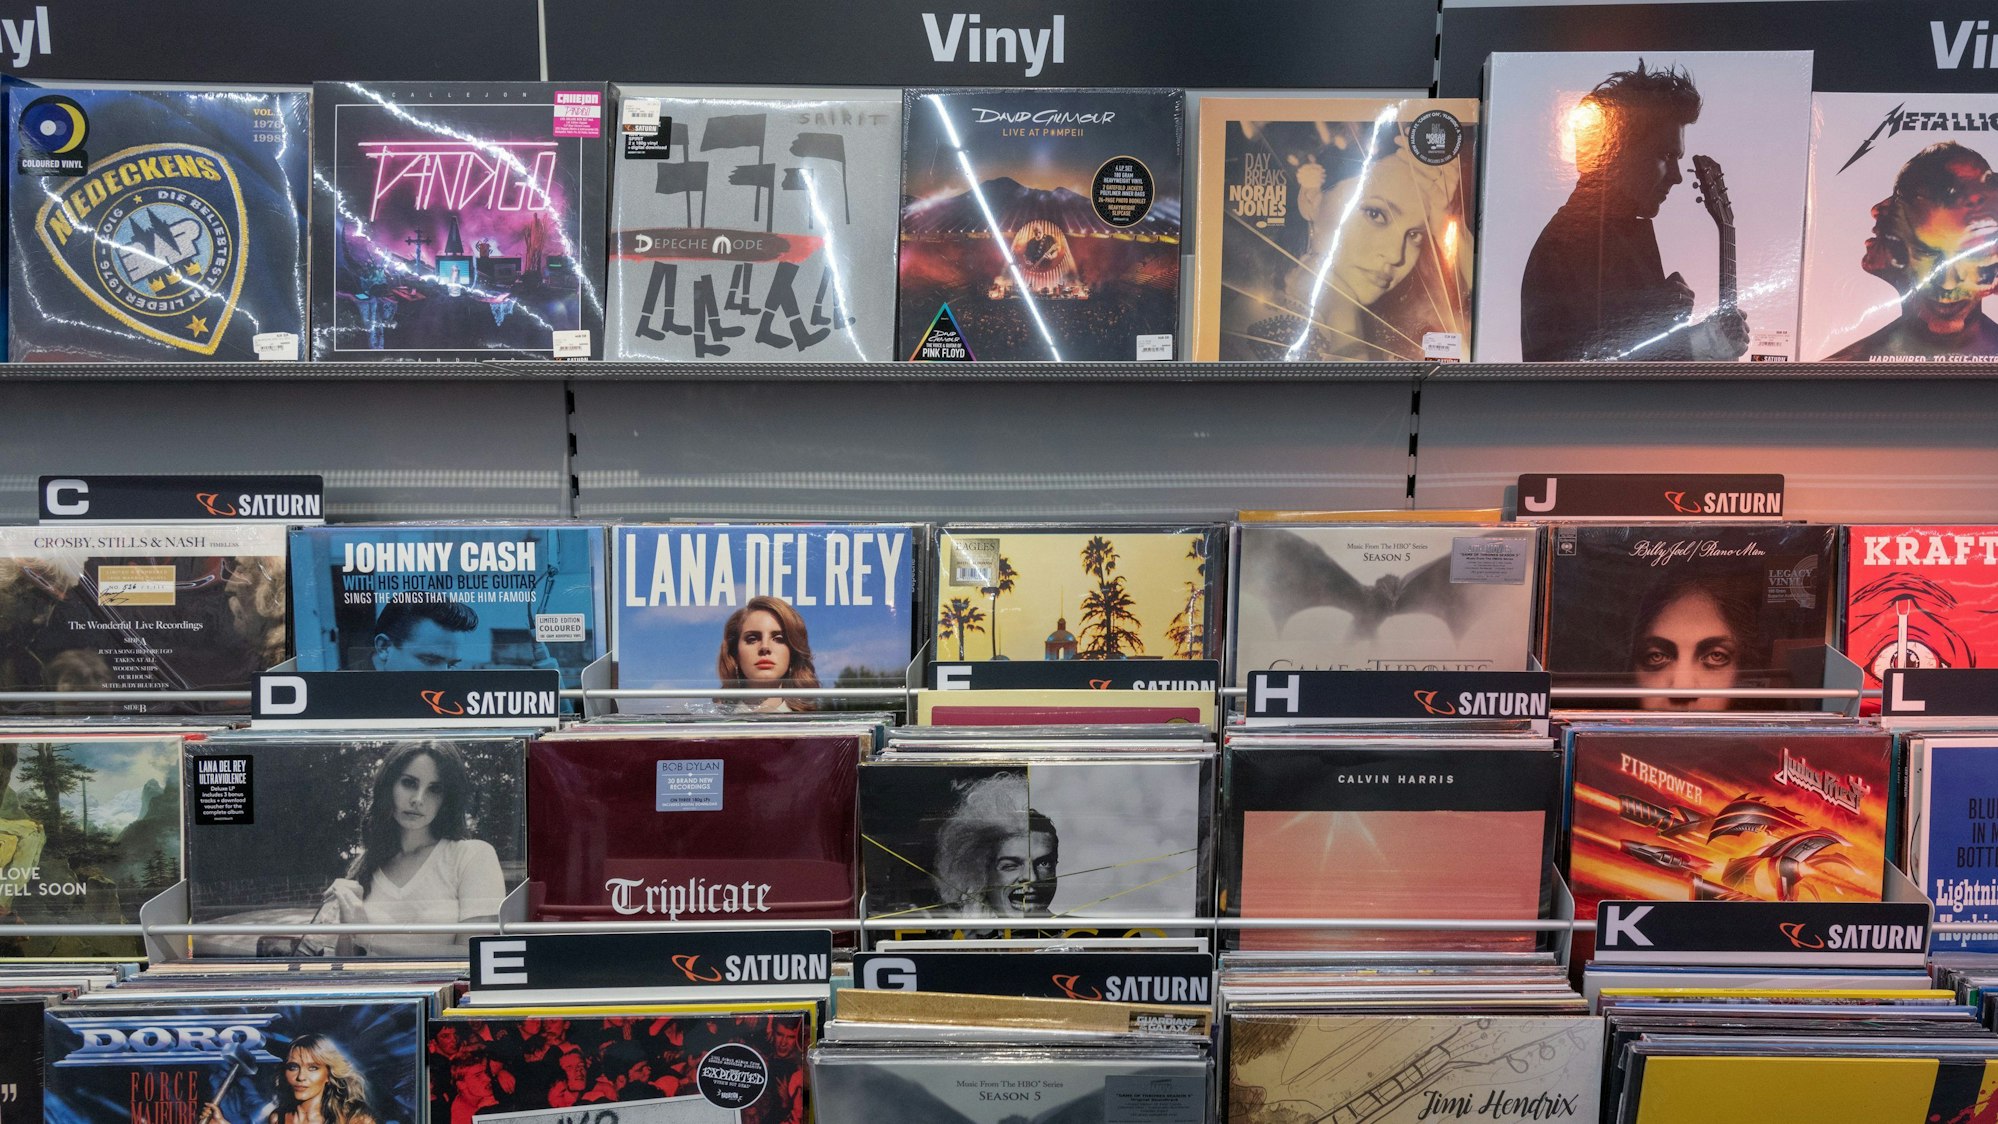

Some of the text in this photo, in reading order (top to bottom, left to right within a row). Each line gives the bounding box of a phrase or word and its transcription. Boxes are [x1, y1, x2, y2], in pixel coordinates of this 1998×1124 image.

[0, 6, 51, 68] yl
[922, 13, 1065, 77] Vinyl
[1930, 20, 1998, 69] Vi
[253, 120, 281, 128] 1976
[798, 108, 889, 126] SPIRIT
[972, 107, 1116, 126] DAVID GILMOUR
[253, 134, 281, 142] 1998
[1002, 128, 1026, 137] LIVE
[1028, 128, 1040, 137] AT
[22, 160, 83, 168] COLOURED VINYL
[1245, 153, 1271, 170] DAY
[1245, 169, 1287, 186] BREAKS
[158, 190, 187, 202] DIE
[1229, 185, 1287, 201] NORAH
[1232, 200, 1287, 216] JONES
[634, 233, 763, 254] DEPECHE MODE
[100, 261, 125, 294] 1976
[125, 293, 185, 311] LIEDER
[922, 348, 966, 358] PINK FLOYD
[46, 479, 89, 516] C
[238, 494, 320, 516] SATURN
[1525, 478, 1557, 512] J
[1704, 492, 1780, 514] SATURN
[34, 537, 205, 548] CROSBY, STILLS & NASH
[955, 542, 997, 550] EAGLES
[1629, 540, 1668, 566] Billy
[1661, 540, 1691, 566] Joel
[1699, 540, 1736, 558] Piano
[1735, 541, 1766, 557] Man
[342, 541, 536, 573] JOHNNY CASH
[1363, 553, 1411, 561] SEASON 5
[626, 533, 737, 607] LANA
[745, 533, 817, 607] DEL
[825, 533, 905, 607] REY
[343, 574, 537, 591] WITH HIS HOT AND BLUE GUITAR
[344, 591, 537, 605] SINGS THE SONGS THAT MADE HIM FAMOUS
[68, 621, 203, 631] The Wonderful Live Recordings
[260, 676, 307, 715] D
[1255, 674, 1300, 712] H
[1891, 673, 1926, 712] L
[140, 704, 147, 713] B
[467, 691, 555, 716] SATURN
[1458, 692, 1546, 716] SATURN
[199, 760, 247, 773] LANA DEL REY
[662, 761, 720, 771] BOB DYLAN
[199, 773, 247, 785] ULTRAVIOLENCE
[1338, 774, 1455, 784] CALVIN HARRIS
[1620, 752, 1703, 805] FIREPOWER
[1968, 797, 1998, 820] BLU
[1972, 822, 1986, 844] IN
[1957, 847, 1998, 868] BOTT
[0, 867, 41, 880] LOVE
[38, 882, 87, 896] SOON
[605, 877, 772, 922] Triplicate
[1935, 879, 1998, 913] Lightni
[1604, 905, 1655, 946] K
[1828, 924, 1923, 950] SATURN
[480, 940, 528, 985] E
[725, 954, 827, 982] SATURN
[862, 958, 918, 992] G
[1105, 976, 1208, 1001] SATURN
[1137, 1016, 1198, 1026] GUARDIANS
[1148, 1024, 1193, 1032] GALAXY
[75, 1025, 267, 1053] DORO
[130, 1071, 198, 1101] FORCE
[702, 1067, 764, 1085] EXPLOITED
[956, 1080, 1064, 1088] Music From The Series
[979, 1090, 1041, 1101] SEASON 5
[1417, 1090, 1579, 1120] Jimi Hendrix
